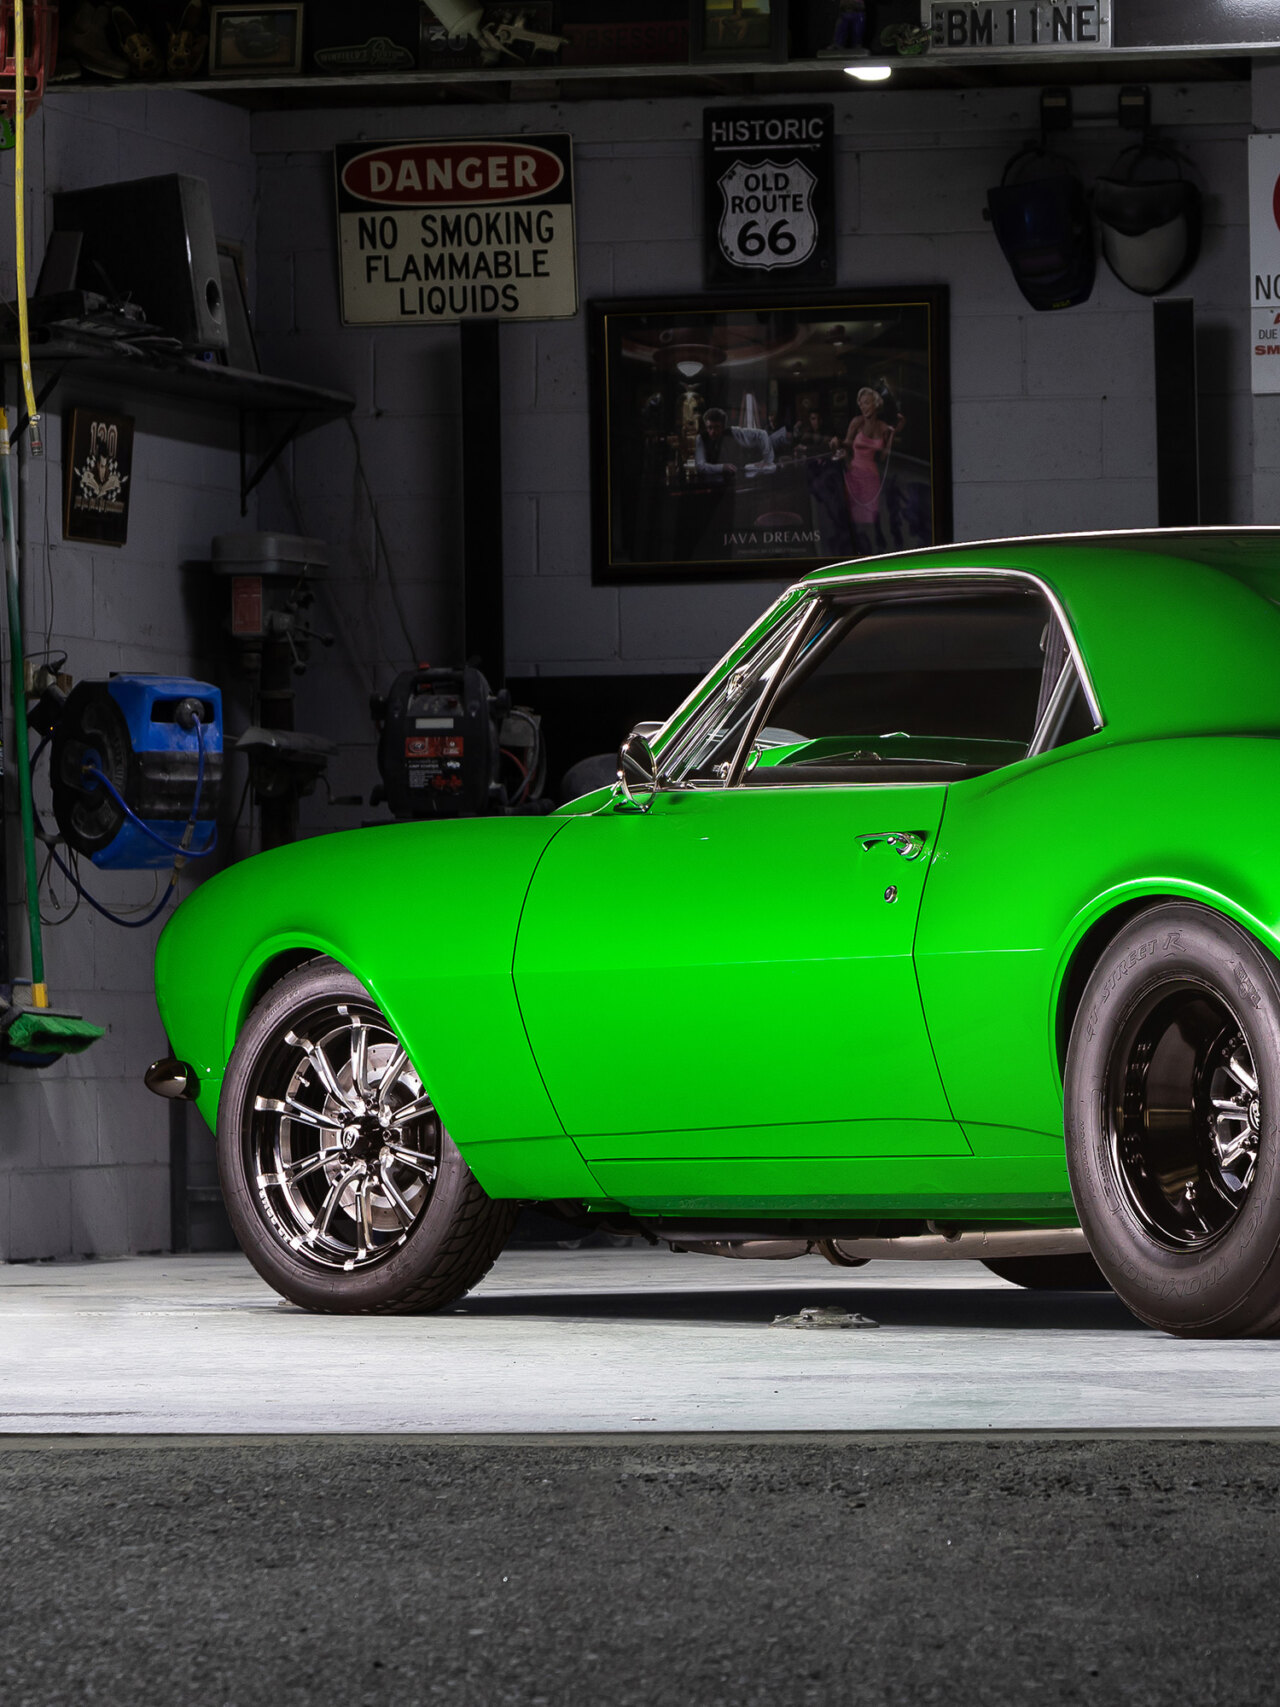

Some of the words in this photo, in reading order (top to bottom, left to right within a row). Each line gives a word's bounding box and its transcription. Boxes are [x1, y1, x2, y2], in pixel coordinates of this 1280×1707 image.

[711, 118, 824, 142] HISTORIC
[368, 154, 538, 193] DANGER
[744, 173, 789, 192] OLD
[731, 194, 804, 214] ROUTE
[358, 215, 398, 250] NO
[420, 210, 554, 248] SMOKING
[737, 219, 796, 257] 66
[366, 250, 550, 283] FLAMMABLE
[400, 284, 519, 315] LIQUIDS
[1258, 328, 1278, 340] DUE
[723, 532, 758, 546] JAVA
[763, 530, 821, 544] DREAMS
[1102, 938, 1158, 1004] STREET
[1162, 932, 1187, 952] R
